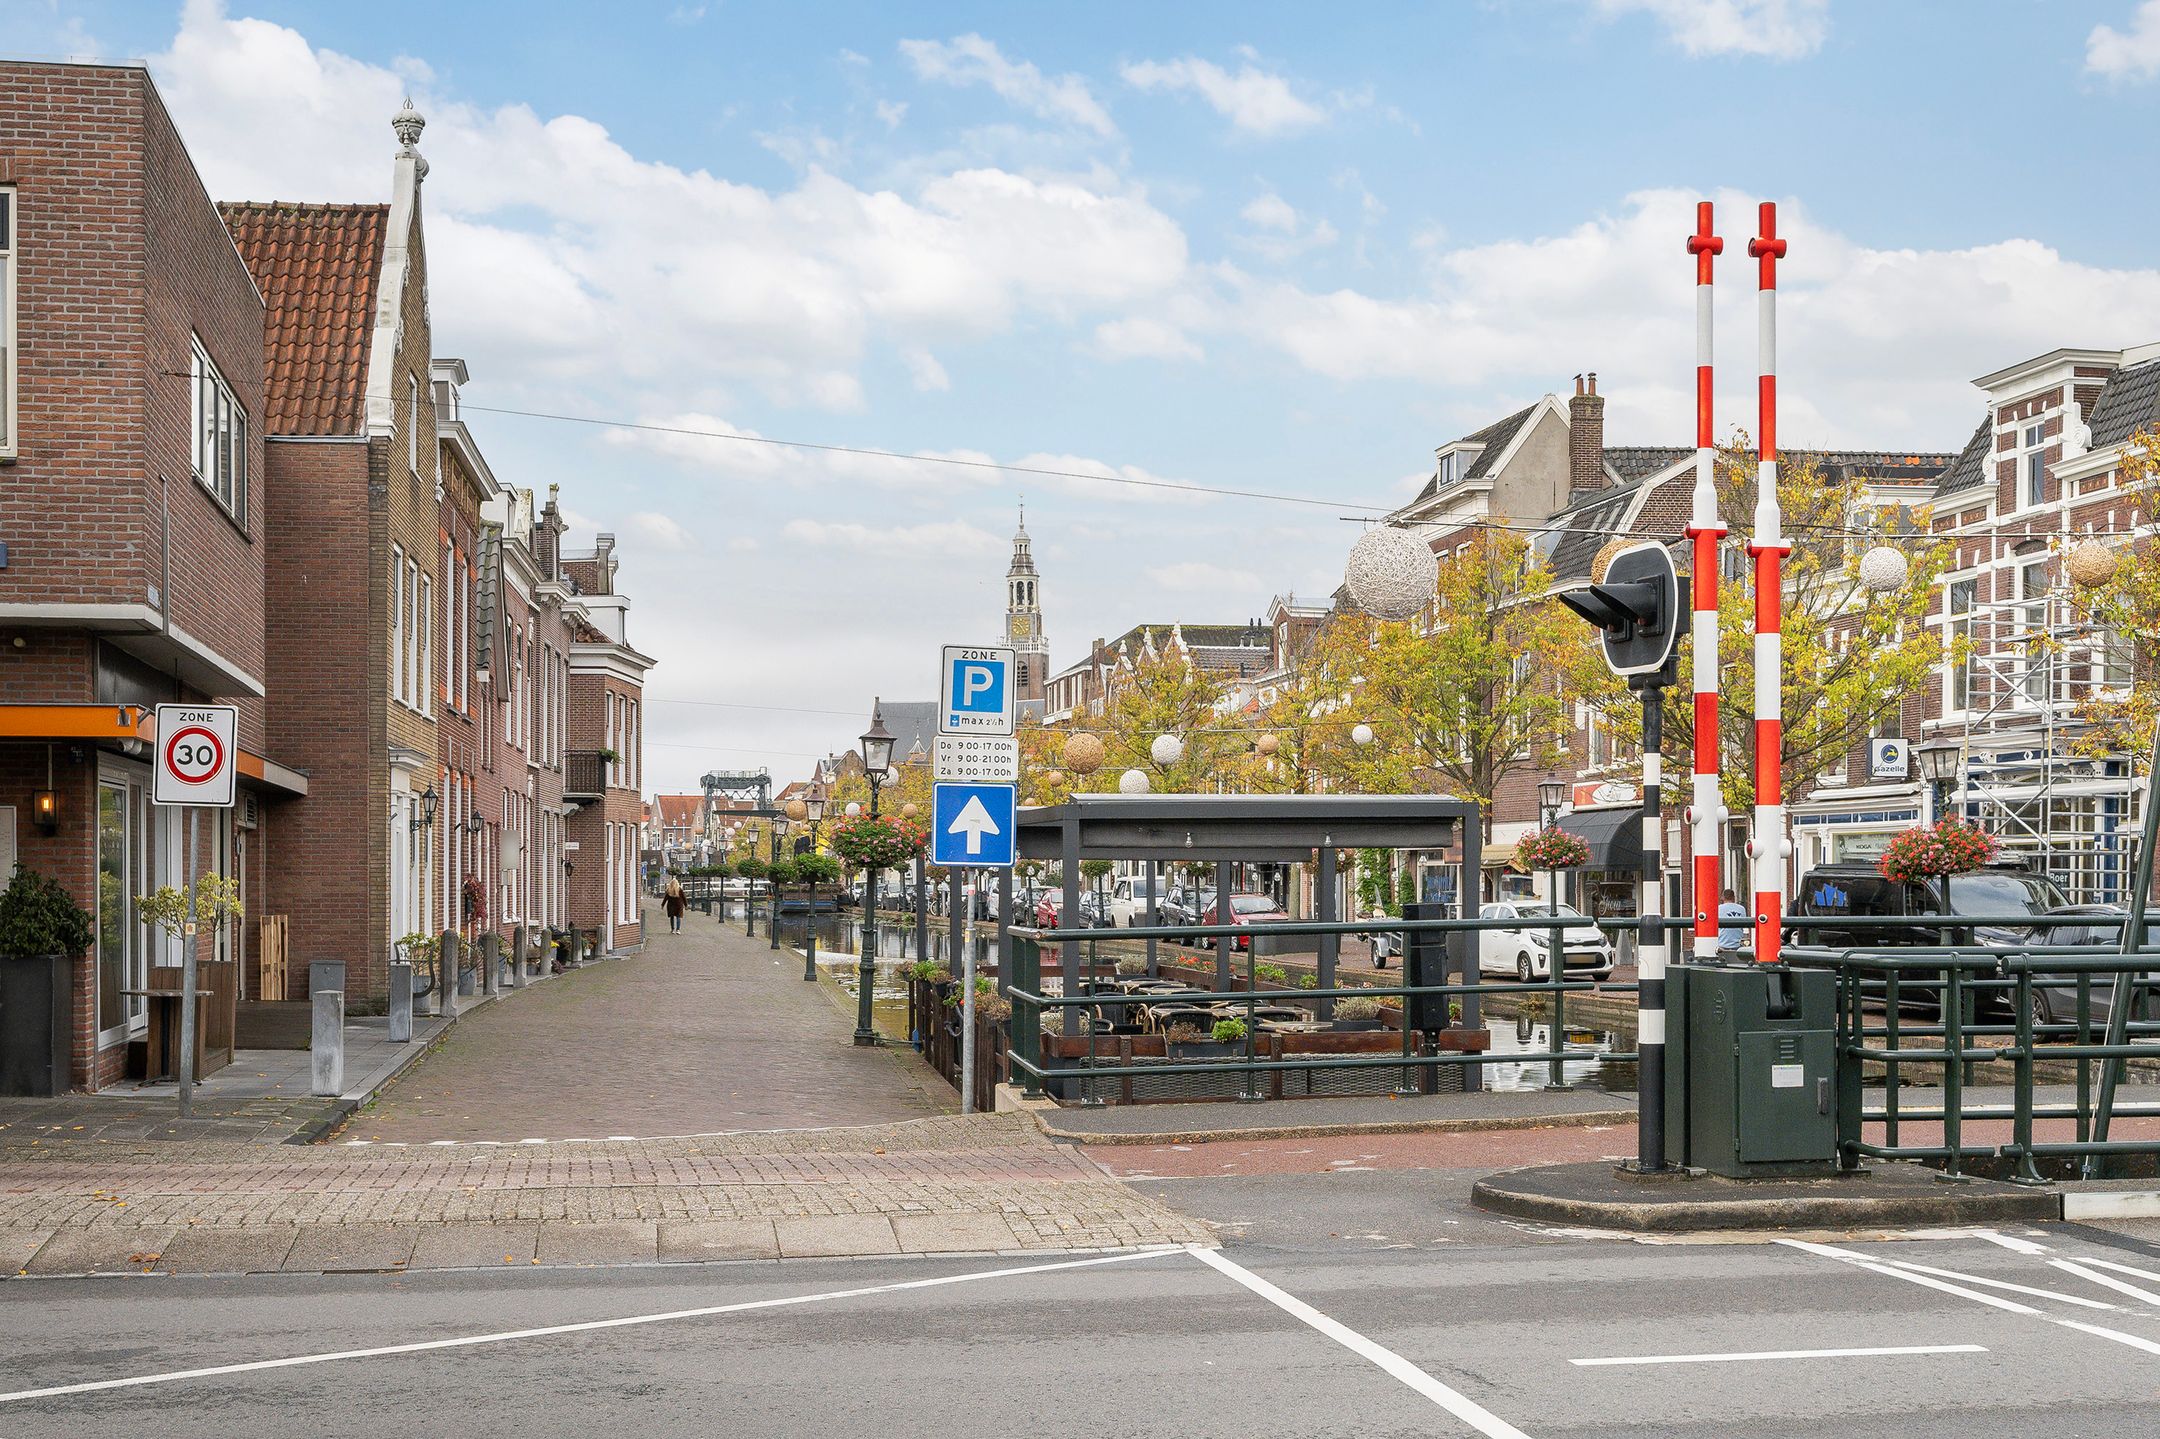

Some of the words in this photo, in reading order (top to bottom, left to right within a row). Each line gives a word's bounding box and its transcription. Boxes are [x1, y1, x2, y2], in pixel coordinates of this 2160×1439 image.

[962, 650, 997, 660] ZONE
[963, 665, 994, 706] P
[179, 712, 214, 722] ZONE
[961, 717, 984, 726] max
[176, 744, 214, 766] 30
